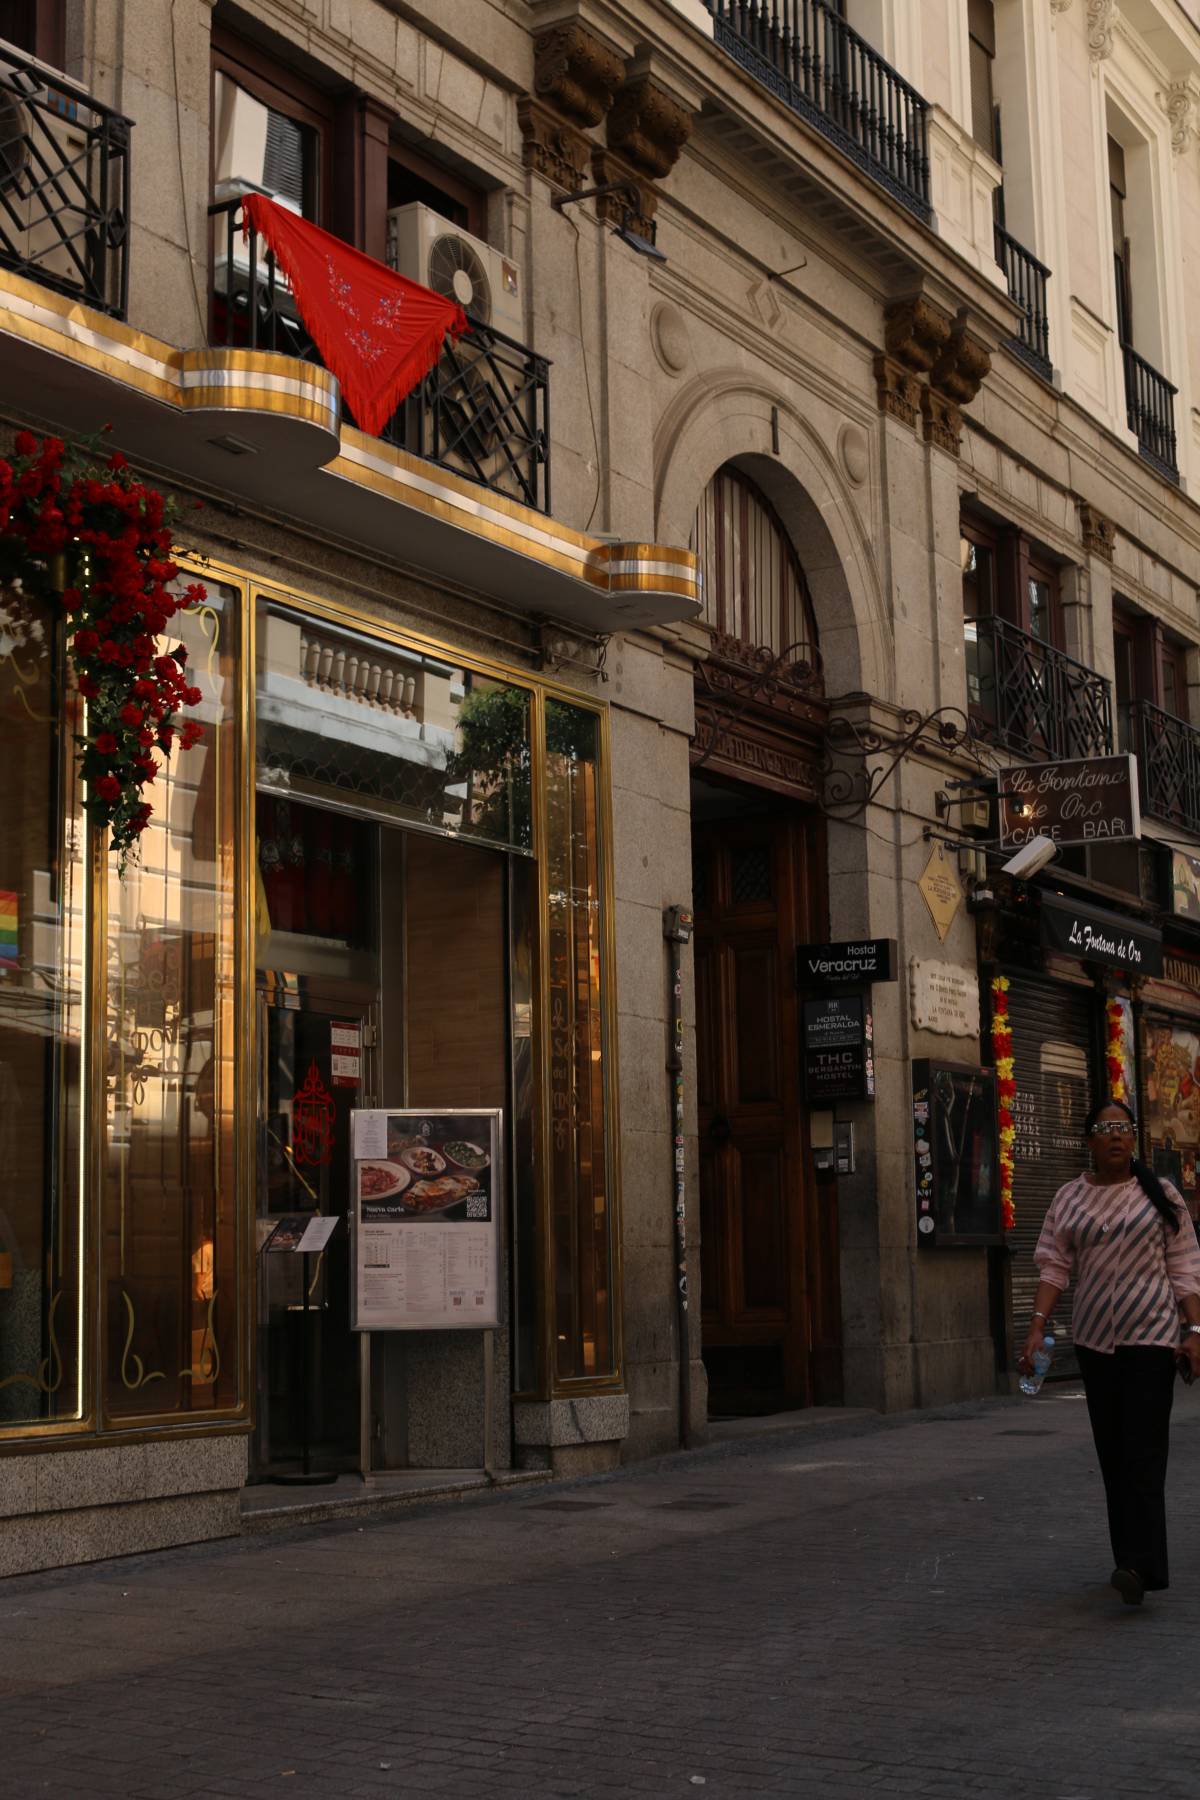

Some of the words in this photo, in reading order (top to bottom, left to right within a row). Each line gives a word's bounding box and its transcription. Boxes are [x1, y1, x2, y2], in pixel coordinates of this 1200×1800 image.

[1011, 769, 1035, 792] La
[1037, 764, 1127, 793] Fontana
[1060, 793, 1102, 820] Oro
[1083, 817, 1125, 838] BAR
[1069, 920, 1082, 944] La
[1084, 926, 1115, 955] Fontana
[1117, 939, 1126, 959] de
[1128, 940, 1141, 962] Oro
[848, 945, 876, 955] Hostal
[808, 959, 877, 974] Veracruz
[808, 1021, 860, 1031] ESMERALDA
[817, 1015, 851, 1024] HOSTAL
[816, 1053, 853, 1065] THC
[817, 1072, 853, 1081] HOSTEL
